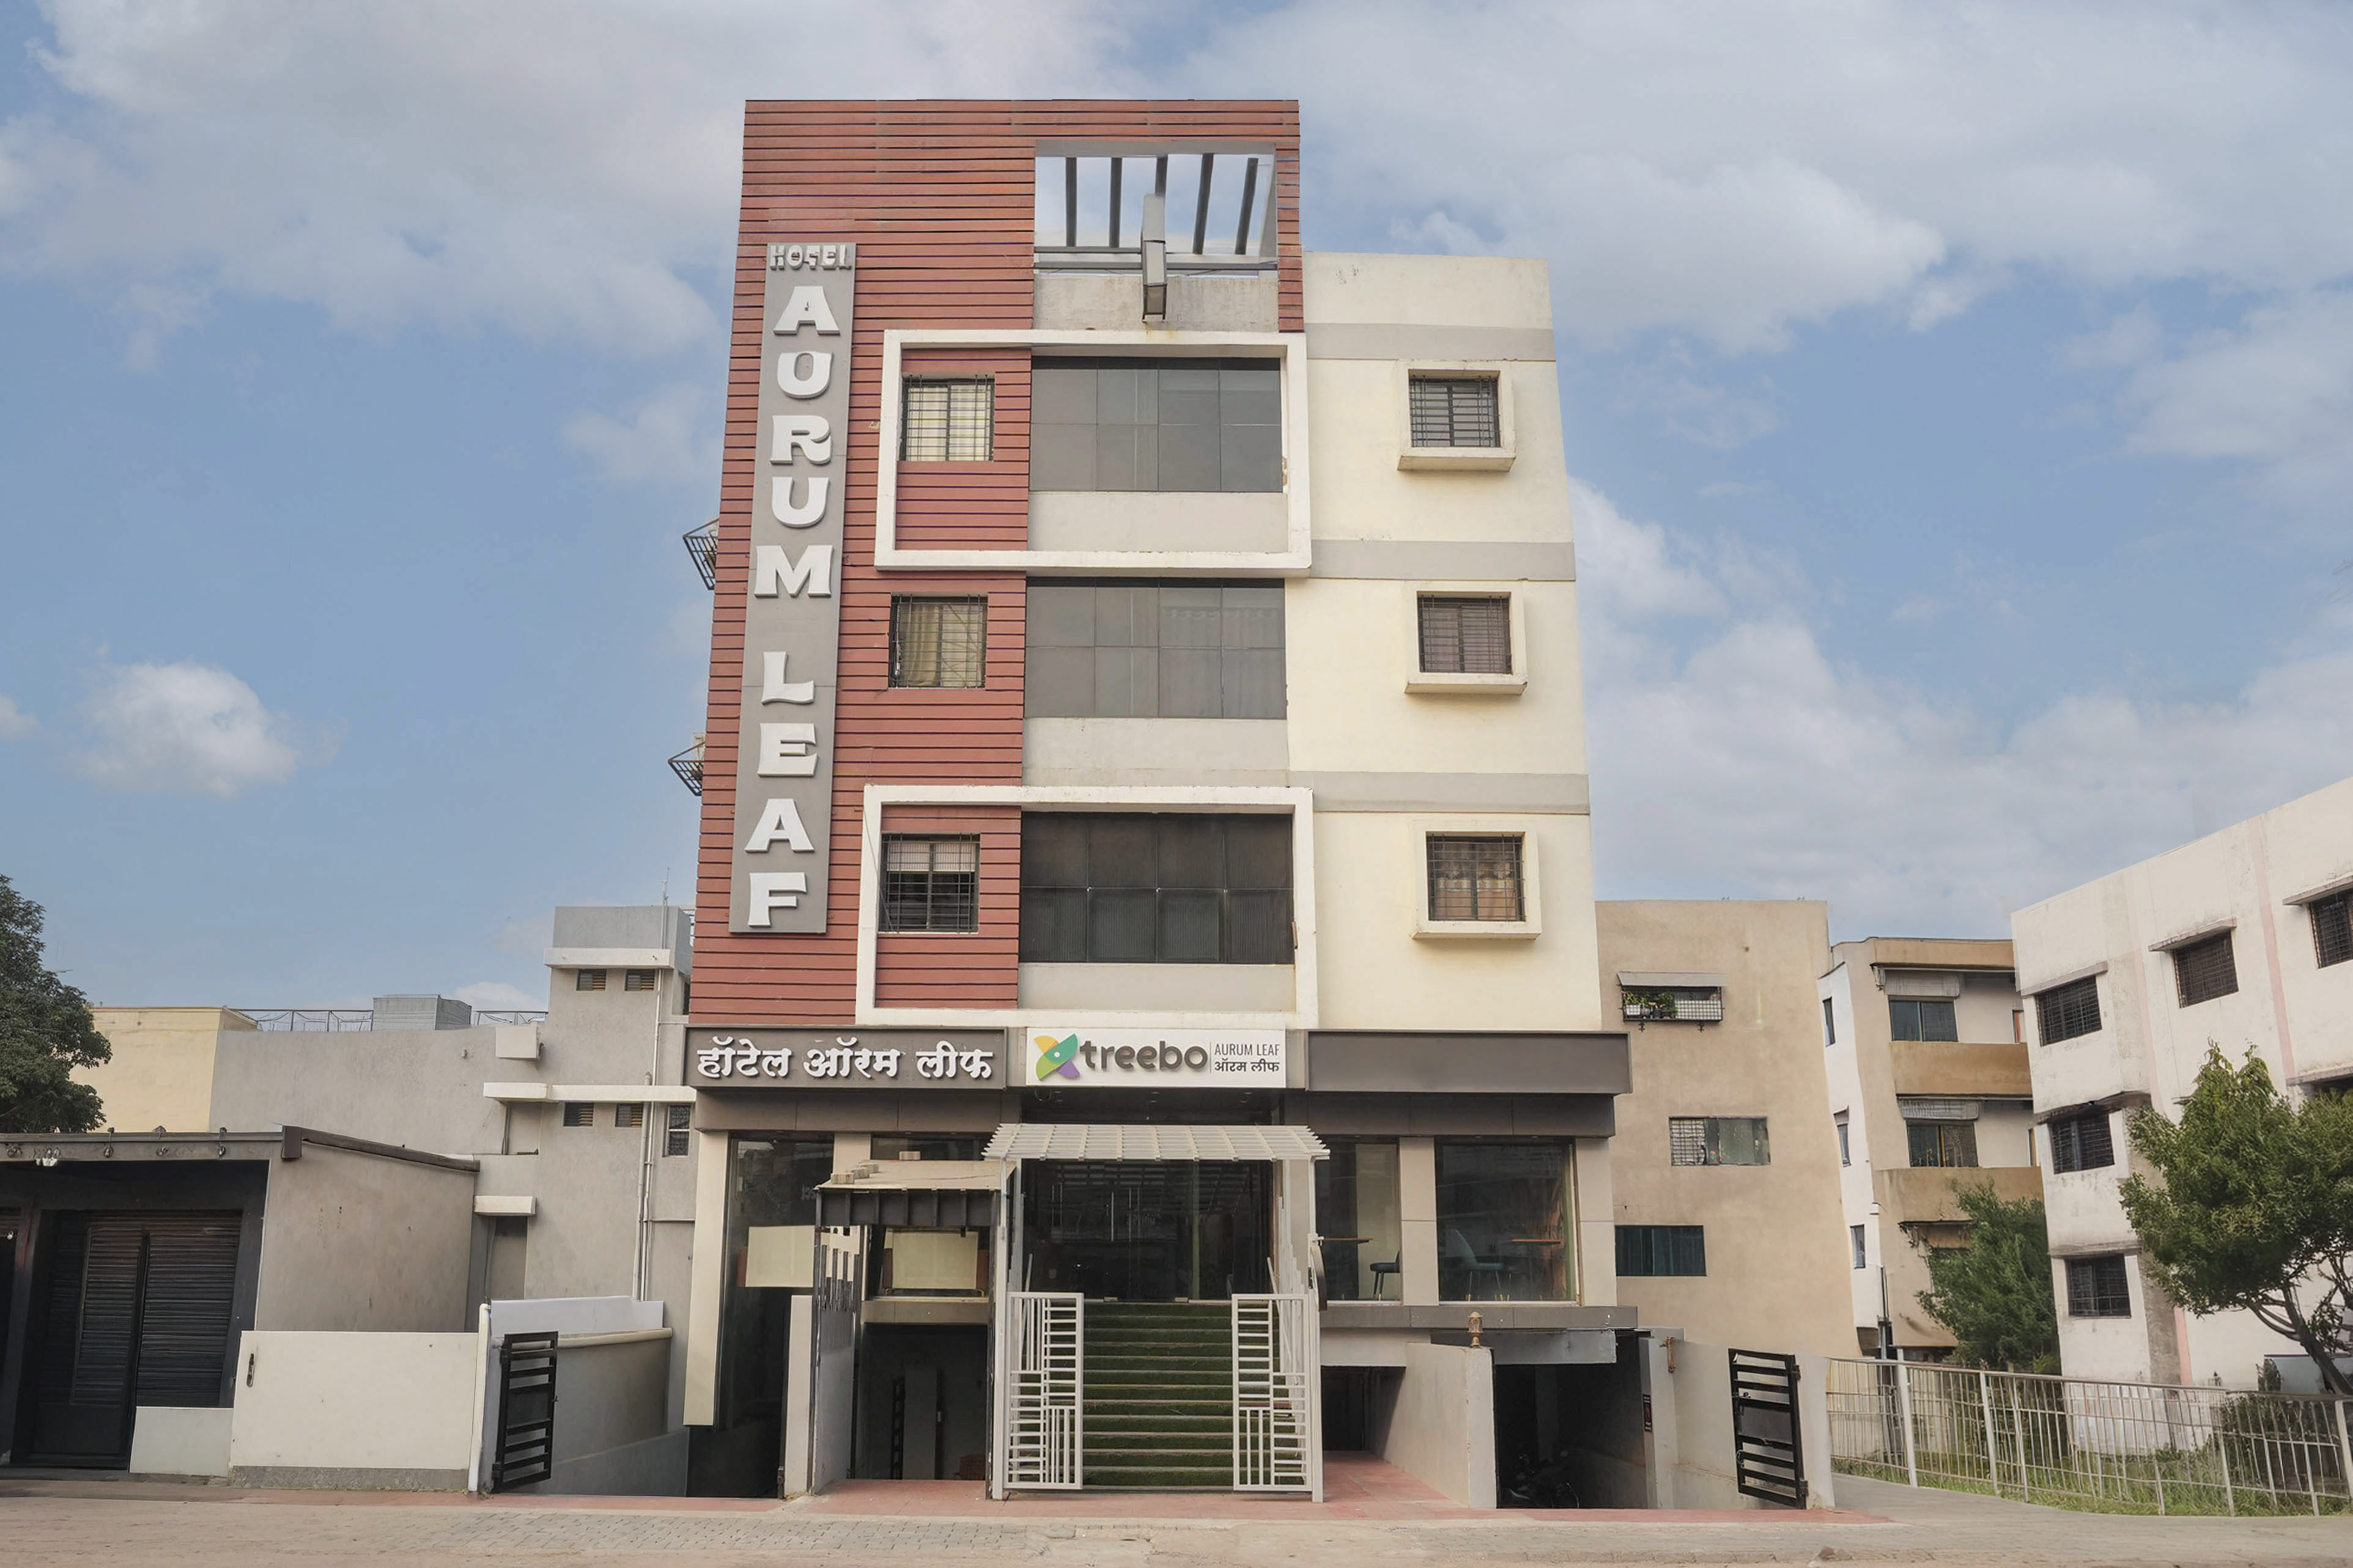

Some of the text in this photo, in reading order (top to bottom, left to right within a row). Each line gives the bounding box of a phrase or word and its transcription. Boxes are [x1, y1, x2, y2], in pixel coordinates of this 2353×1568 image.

[769, 245, 852, 270] HOTEL
[744, 285, 840, 927] AURUM LEAF
[696, 1036, 994, 1079] हॉटेल ऑरम लीफ
[1079, 1040, 1208, 1072] treebo
[1214, 1043, 1280, 1056] AURUM LEAF
[1214, 1058, 1280, 1072] ऑरम लीफ
